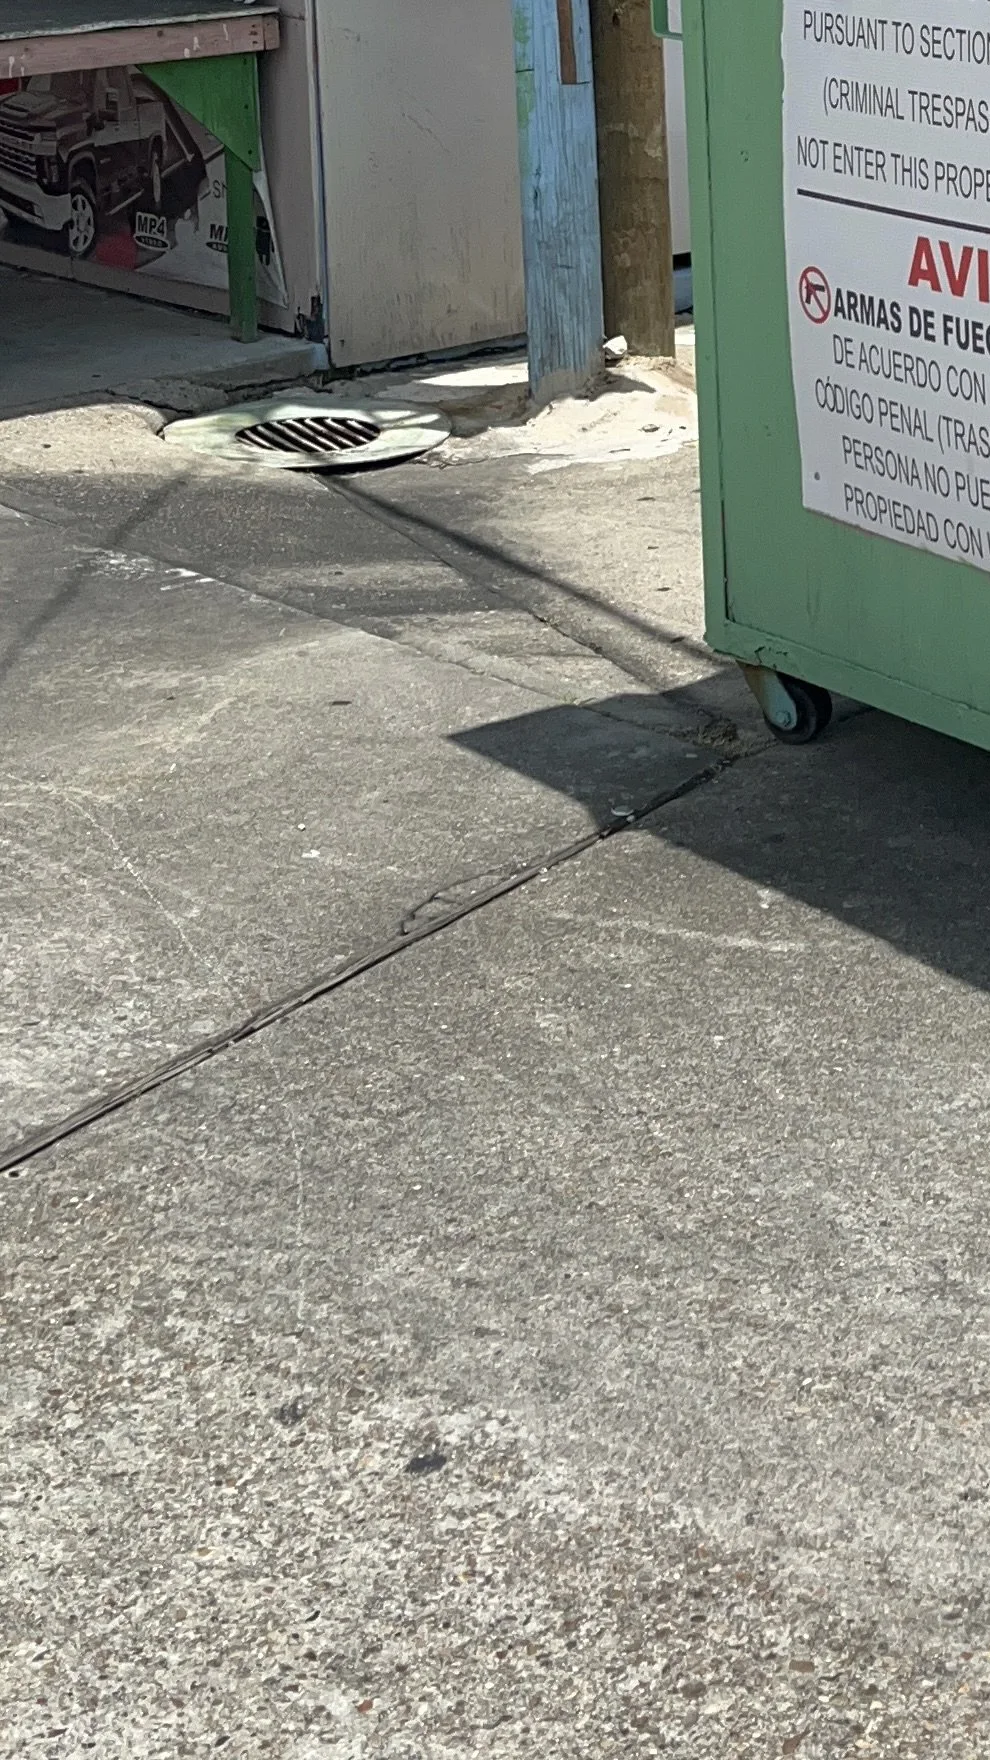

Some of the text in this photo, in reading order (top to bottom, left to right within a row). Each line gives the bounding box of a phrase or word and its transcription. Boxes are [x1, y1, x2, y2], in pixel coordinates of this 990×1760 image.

[804, 10, 887, 51] PURSUANT
[892, 21, 914, 54] TO
[824, 77, 904, 120] (CRIMINAL
[797, 136, 828, 170] NOT
[833, 142, 886, 183] ENTER
[891, 153, 928, 190] THIS
[833, 288, 901, 333] ARMAS
[909, 306, 935, 342] DE
[833, 334, 853, 367] DE
[859, 344, 940, 391] ACUERDO
[947, 365, 985, 404] CON
[815, 376, 873, 423] CÓDIGO
[879, 398, 933, 442] PENAL
[842, 435, 922, 490] PERSONA
[925, 462, 950, 498] NO
[844, 483, 939, 542] PROPIEDAD
[944, 519, 983, 558] CON
